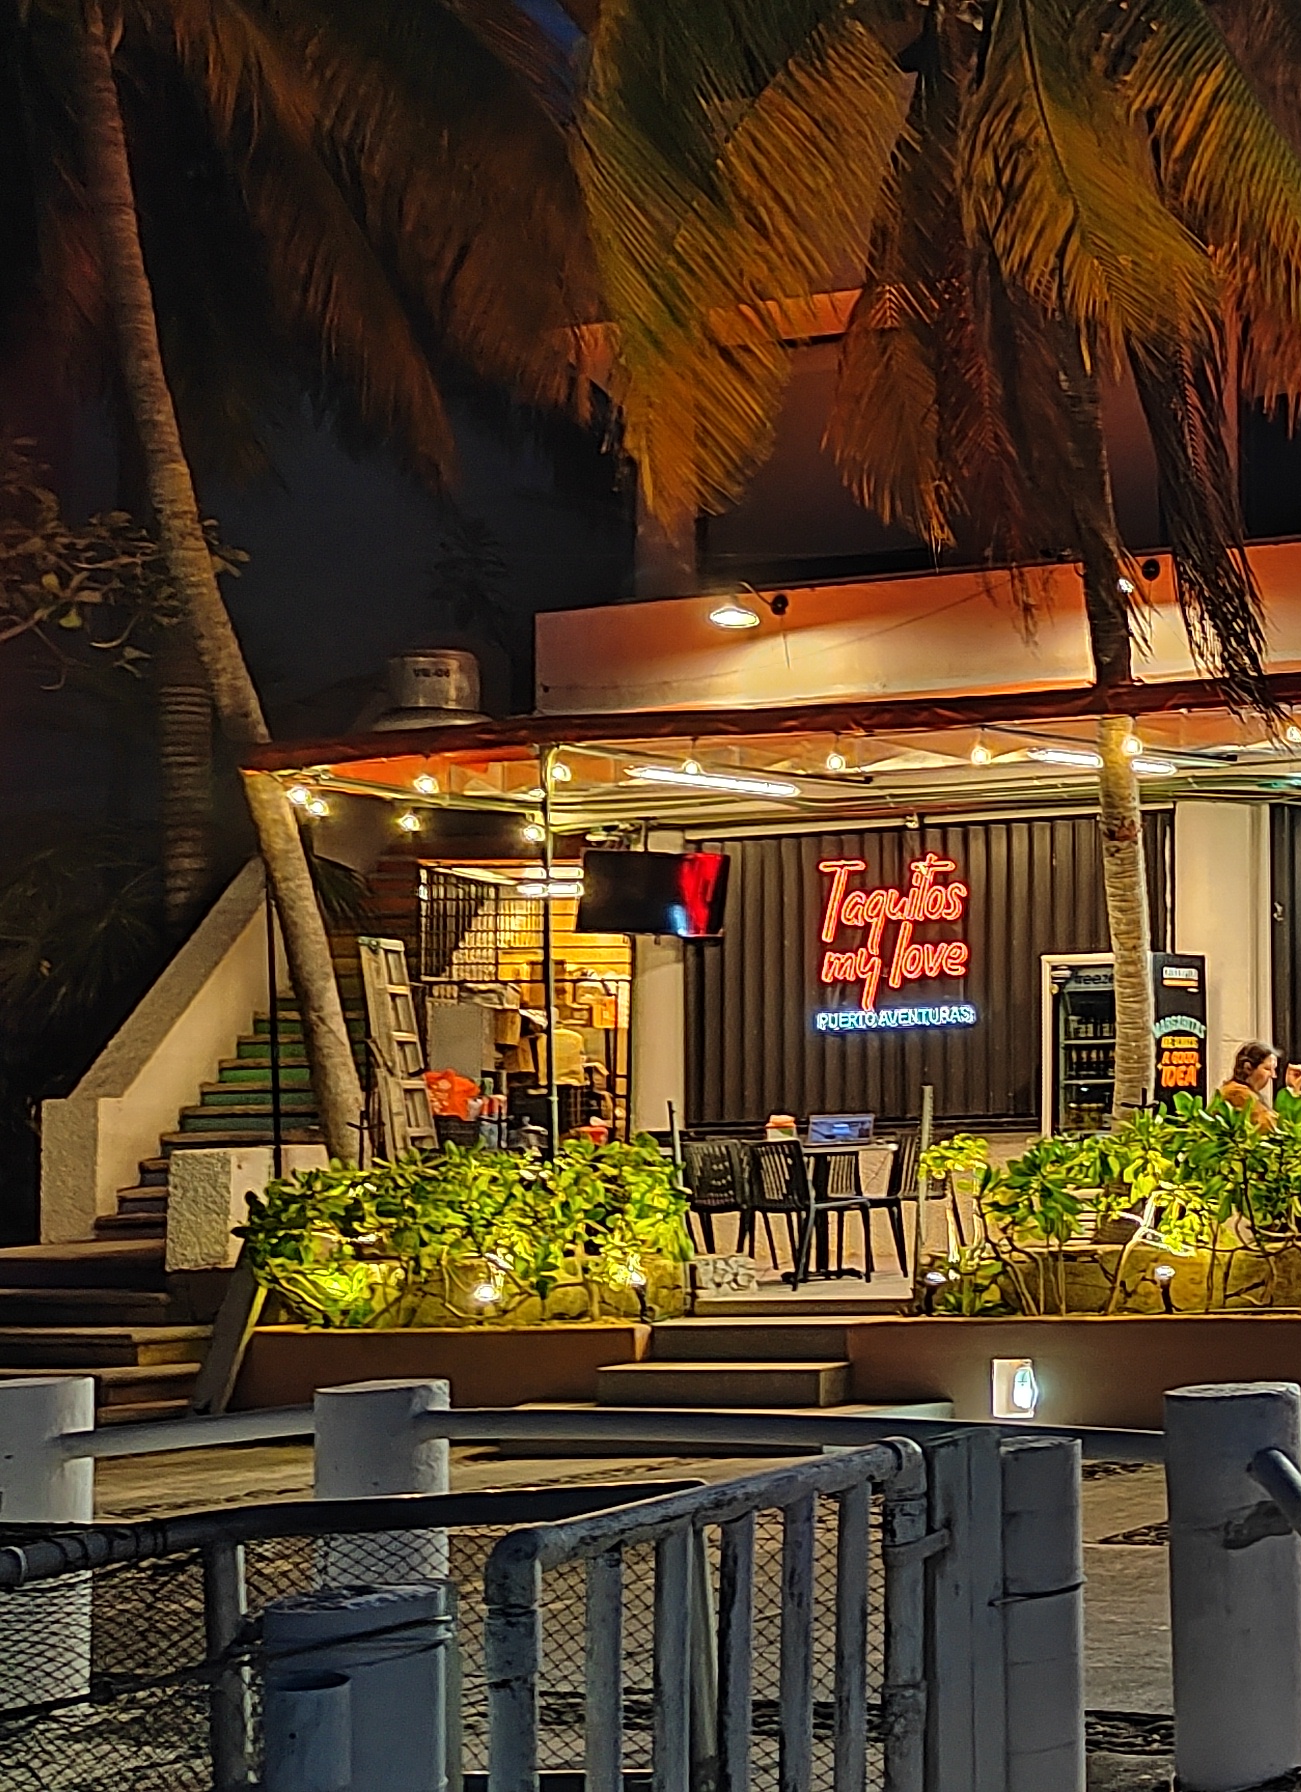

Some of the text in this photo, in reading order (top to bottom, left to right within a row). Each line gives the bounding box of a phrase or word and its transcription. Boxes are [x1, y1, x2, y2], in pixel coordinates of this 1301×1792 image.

[818, 853, 968, 955] Taquitos
[821, 920, 969, 1012] my love
[816, 1004, 977, 1031] PUERTO AVENTURAS
[1161, 1065, 1197, 1087] IDEA
